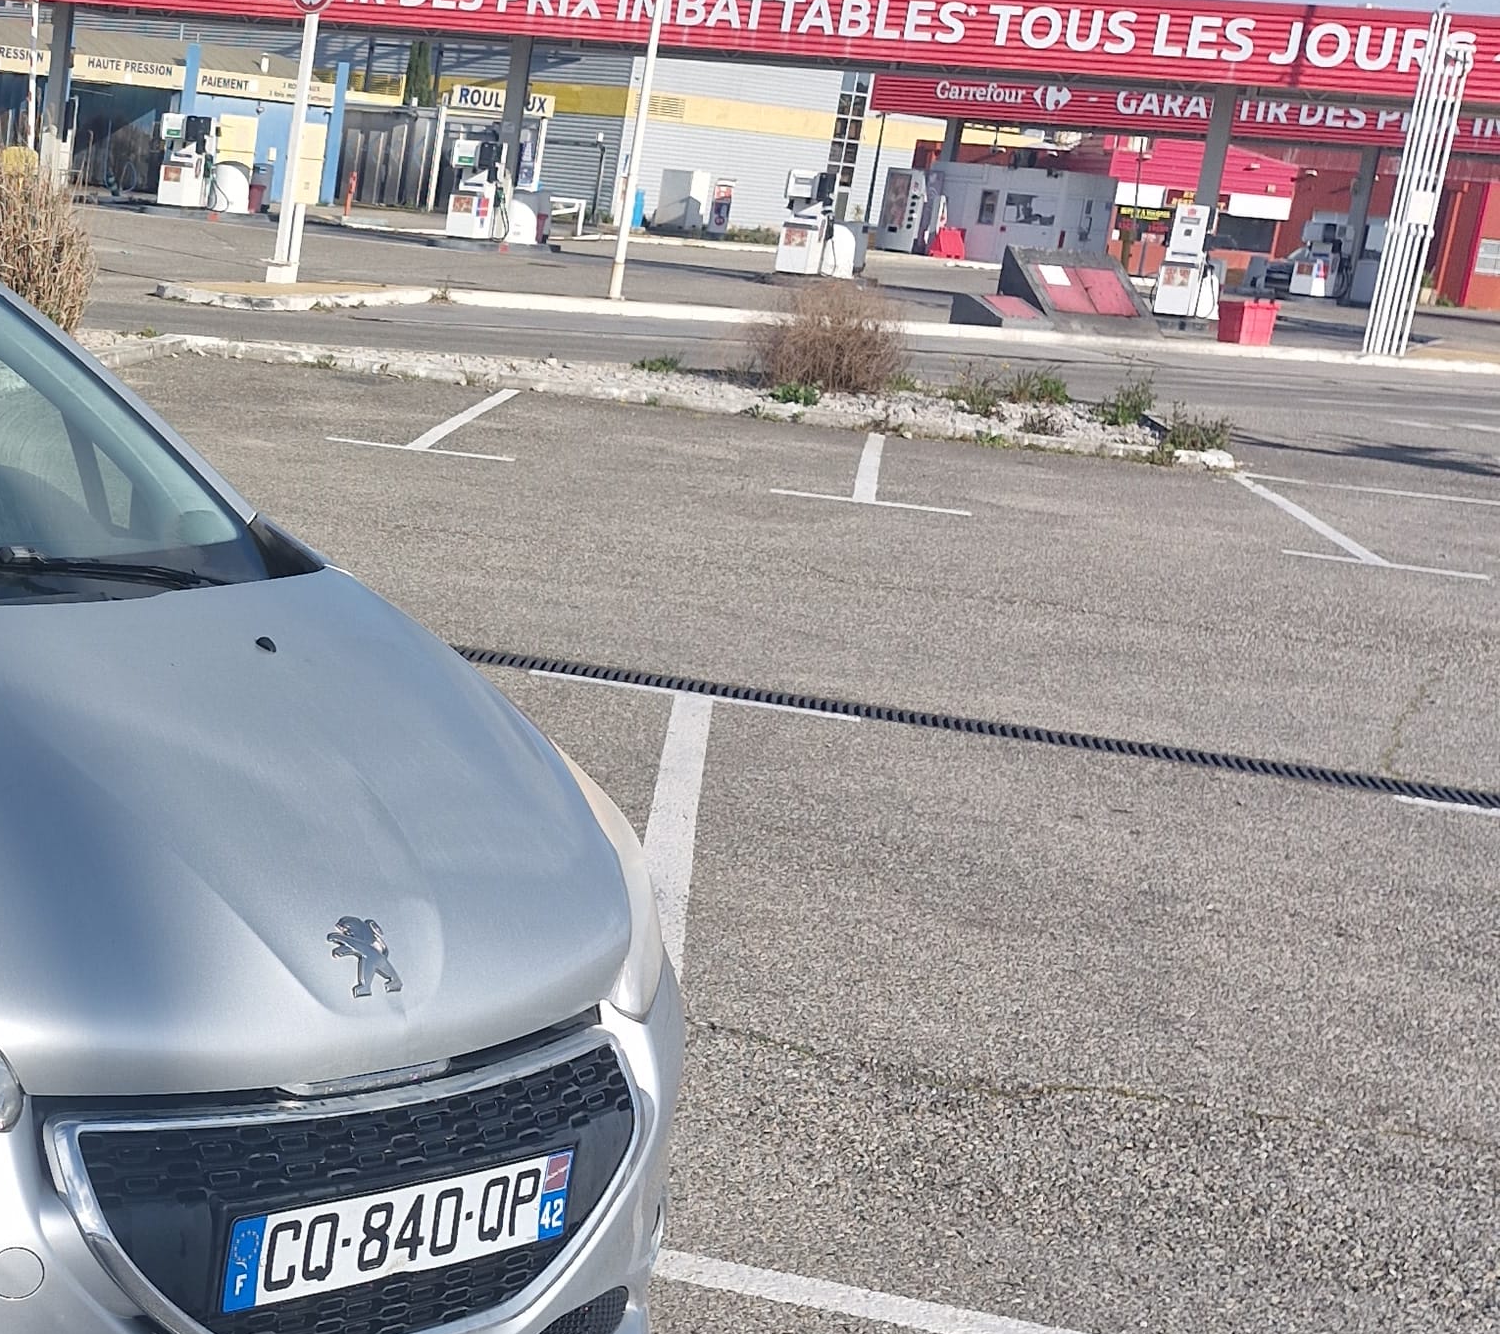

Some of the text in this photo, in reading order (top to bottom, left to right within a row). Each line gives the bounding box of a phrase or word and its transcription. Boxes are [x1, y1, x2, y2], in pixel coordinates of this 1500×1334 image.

[988, 3, 1137, 55] TOUS
[1151, 13, 1256, 62] LES
[88, 57, 173, 77] HAUTE PRESSION
[201, 75, 249, 91] PAIEMENT
[935, 80, 1026, 104] Carrefour
[458, 87, 548, 114] ROULUX
[539, 1198, 566, 1230] 42
[263, 1167, 542, 1293] CQ-840-QP
[233, 1273, 248, 1296] F
